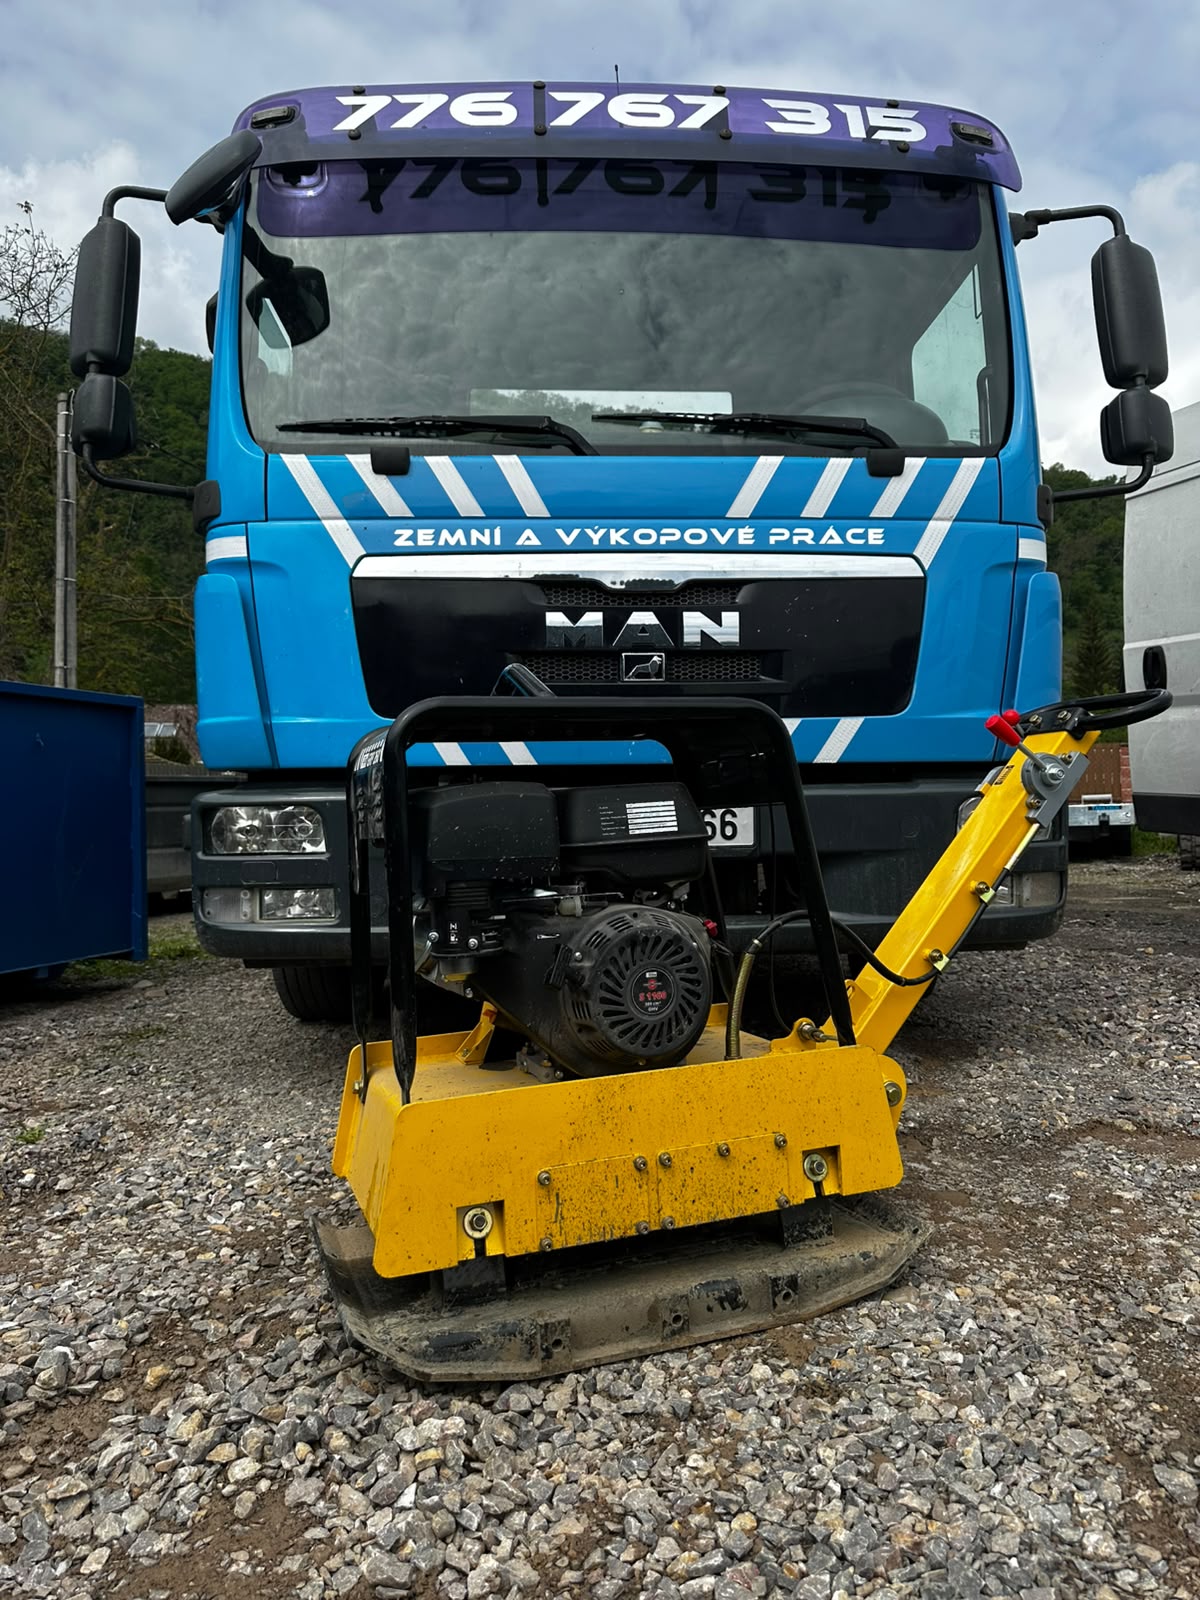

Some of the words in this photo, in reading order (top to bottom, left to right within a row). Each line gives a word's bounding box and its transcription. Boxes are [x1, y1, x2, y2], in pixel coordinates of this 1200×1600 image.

[332, 91, 518, 132] 776
[548, 91, 730, 129] 767
[761, 97, 928, 143] 315
[393, 526, 502, 547] ZEMNÍ
[515, 528, 541, 547] A
[555, 525, 757, 547] VÝKOPOVÉ
[768, 526, 886, 546] PRÁCE
[545, 611, 741, 647] MAN
